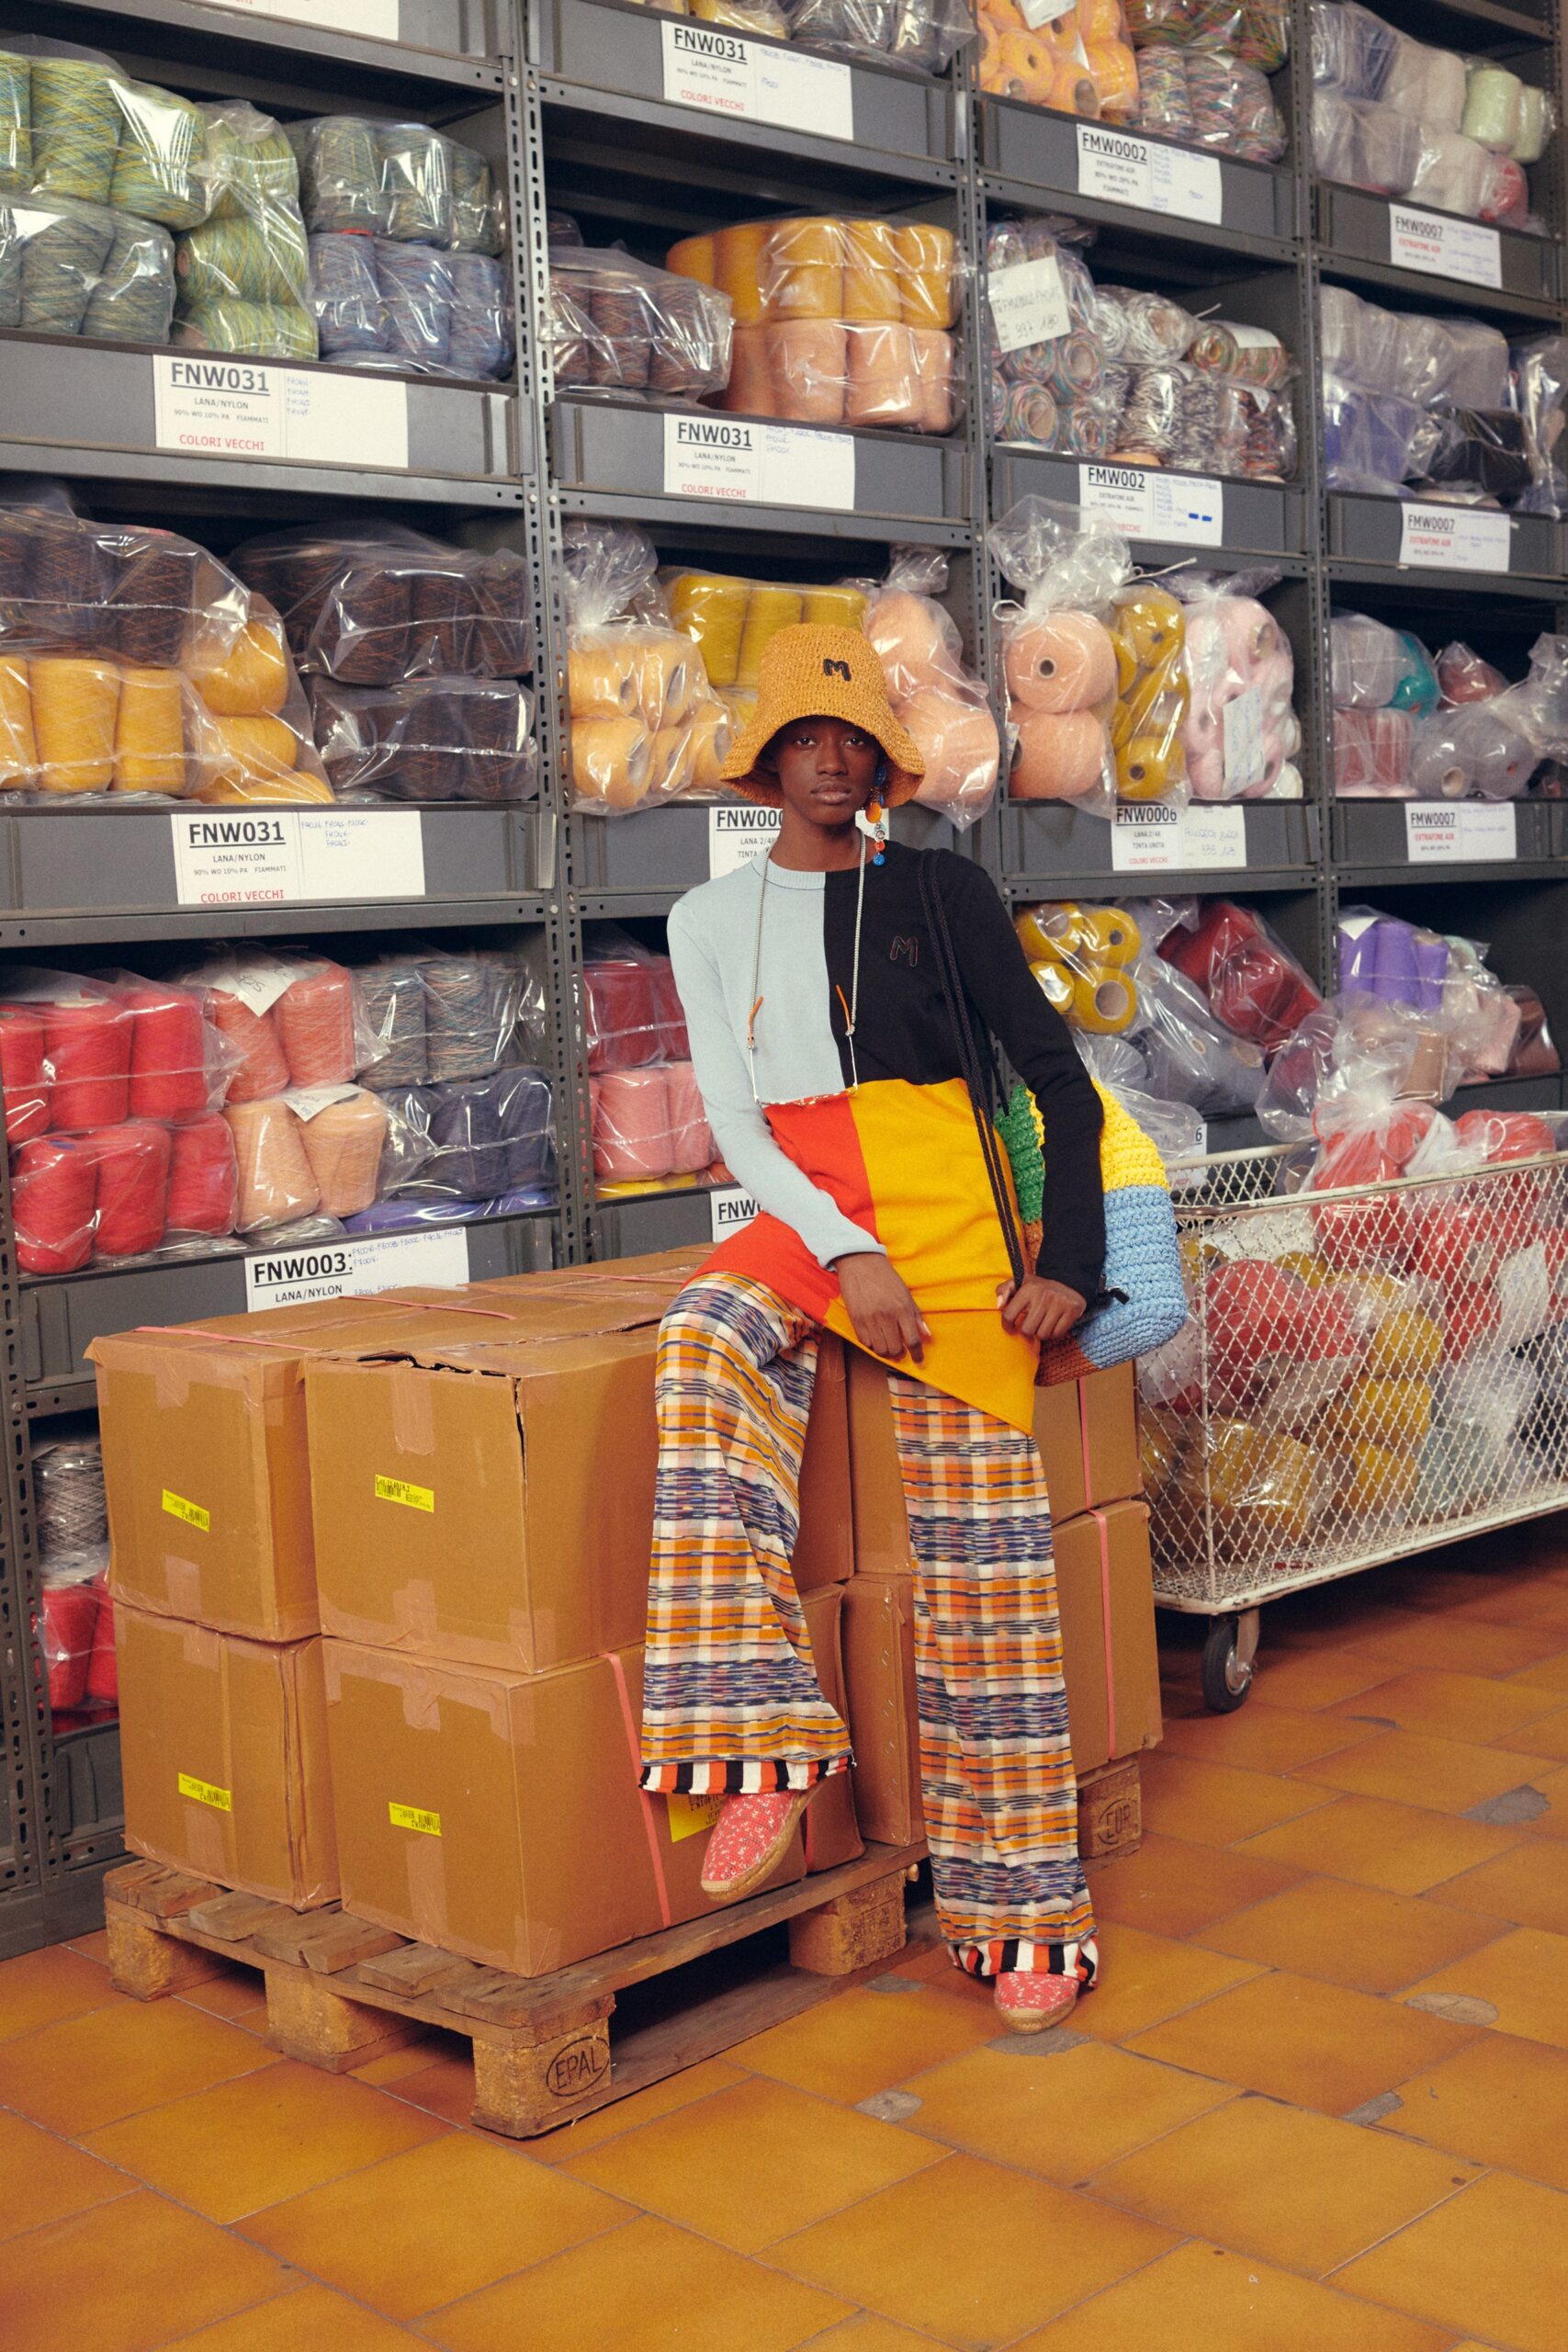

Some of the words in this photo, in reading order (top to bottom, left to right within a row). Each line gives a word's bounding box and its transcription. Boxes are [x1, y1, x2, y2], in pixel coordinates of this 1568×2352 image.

[673, 28, 747, 61] FNW031
[691, 59, 732, 74] LANA/NYLON
[681, 89, 713, 106] COLORI
[715, 96, 745, 111] VECCHI
[1082, 132, 1147, 162] FMW0002
[1395, 216, 1443, 239] FMW0007
[171, 362, 269, 392] FNW031
[194, 397, 249, 410] LANA/NYLON
[236, 414, 269, 424] FIAMMATI
[179, 434, 221, 447] COLORI
[224, 438, 265, 451] VECCHI
[677, 422, 752, 447] FNW031
[694, 451, 736, 462] LANA/NYLON
[1088, 467, 1145, 489] FMW002
[682, 483, 713, 495] COLORI
[716, 487, 746, 498] VECCHI
[1408, 514, 1455, 531] FMW0007
[823, 658, 852, 682] M
[1116, 807, 1177, 823] FNW0006
[1411, 812, 1455, 825] FMW0007
[189, 820, 285, 844] FNW031
[740, 837, 758, 845] LANA
[212, 854, 265, 863] LANA/NYLON
[254, 865, 287, 873] FIAMMATI
[200, 891, 242, 903] COLORI
[245, 889, 285, 901] VECCHI
[890, 935, 918, 967] M
[718, 1199, 761, 1221] FNW
[254, 1251, 353, 1283] FNW003
[276, 1284, 343, 1303] LANA/NYLON
[556, 2046, 604, 2089] EPAL
